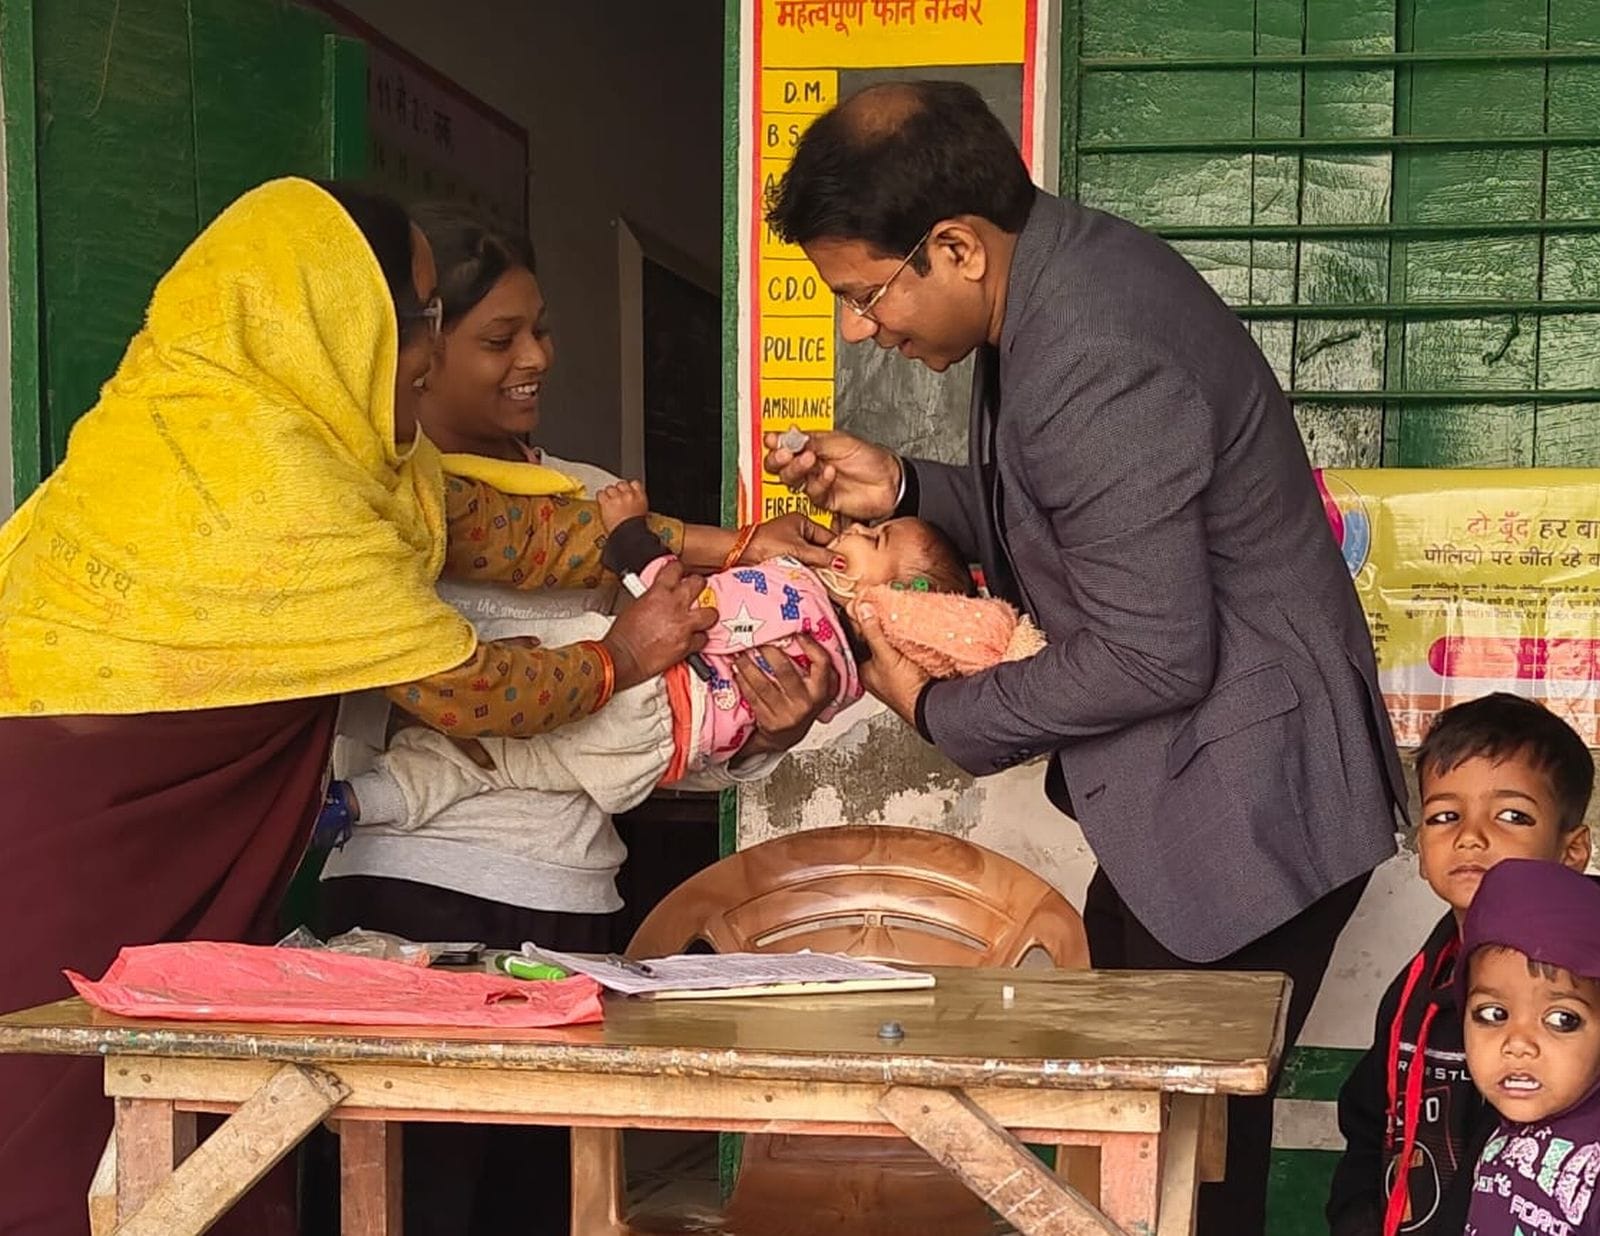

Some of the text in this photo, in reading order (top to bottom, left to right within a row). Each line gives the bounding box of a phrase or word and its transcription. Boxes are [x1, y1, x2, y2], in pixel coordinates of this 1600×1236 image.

[764, 336, 826, 363] POLICE
[763, 396, 832, 420] AMBULANCE
[1467, 511, 1490, 534] दो
[1498, 511, 1532, 544] बूँद
[1539, 518, 1570, 539] हर
[1425, 543, 1483, 566] पोलियो
[1490, 549, 1514, 566] पर
[1519, 545, 1553, 567] जीत
[1560, 546, 1583, 568] रहे
